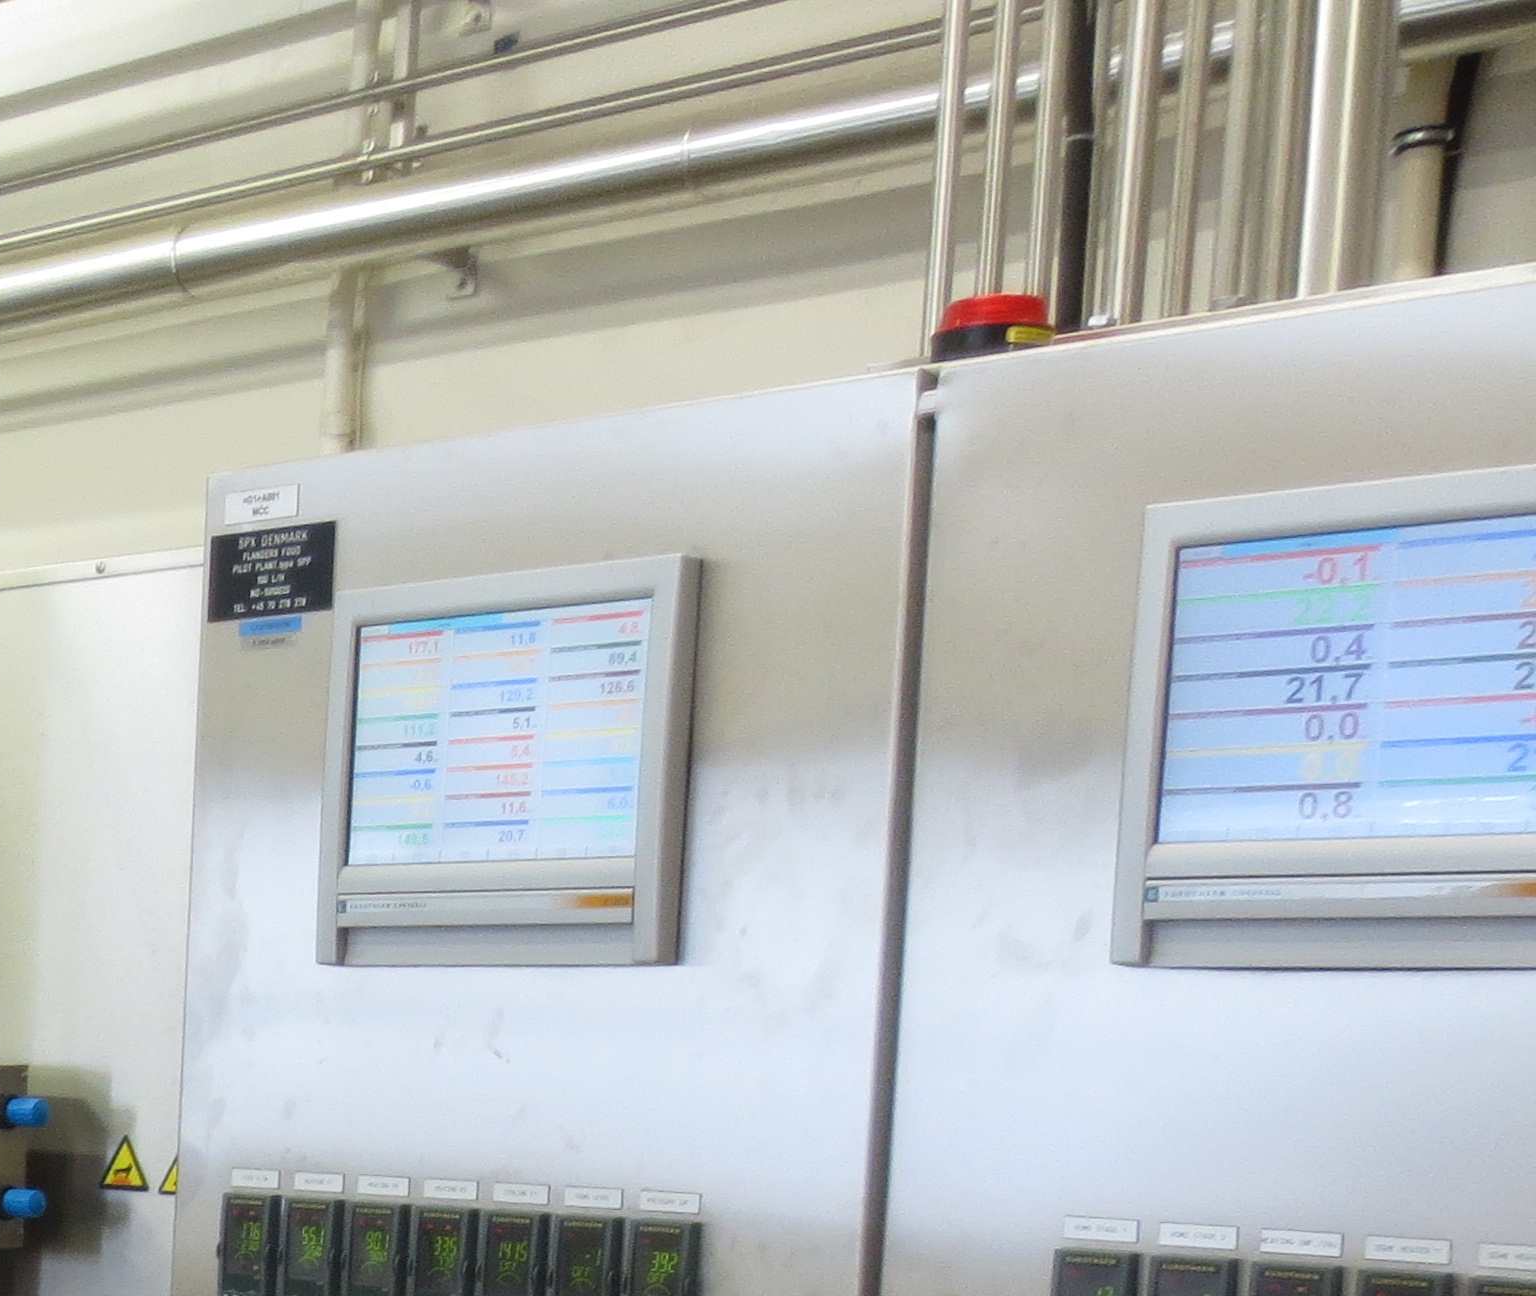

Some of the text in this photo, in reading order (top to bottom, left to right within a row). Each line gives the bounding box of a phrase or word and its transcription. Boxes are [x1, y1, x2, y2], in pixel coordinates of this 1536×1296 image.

[238, 530, 309, 550] SPX DENMARK
[242, 548, 279, 561] FLANDERS
[232, 562, 252, 574] PILOT
[255, 560, 277, 573] PLANT
